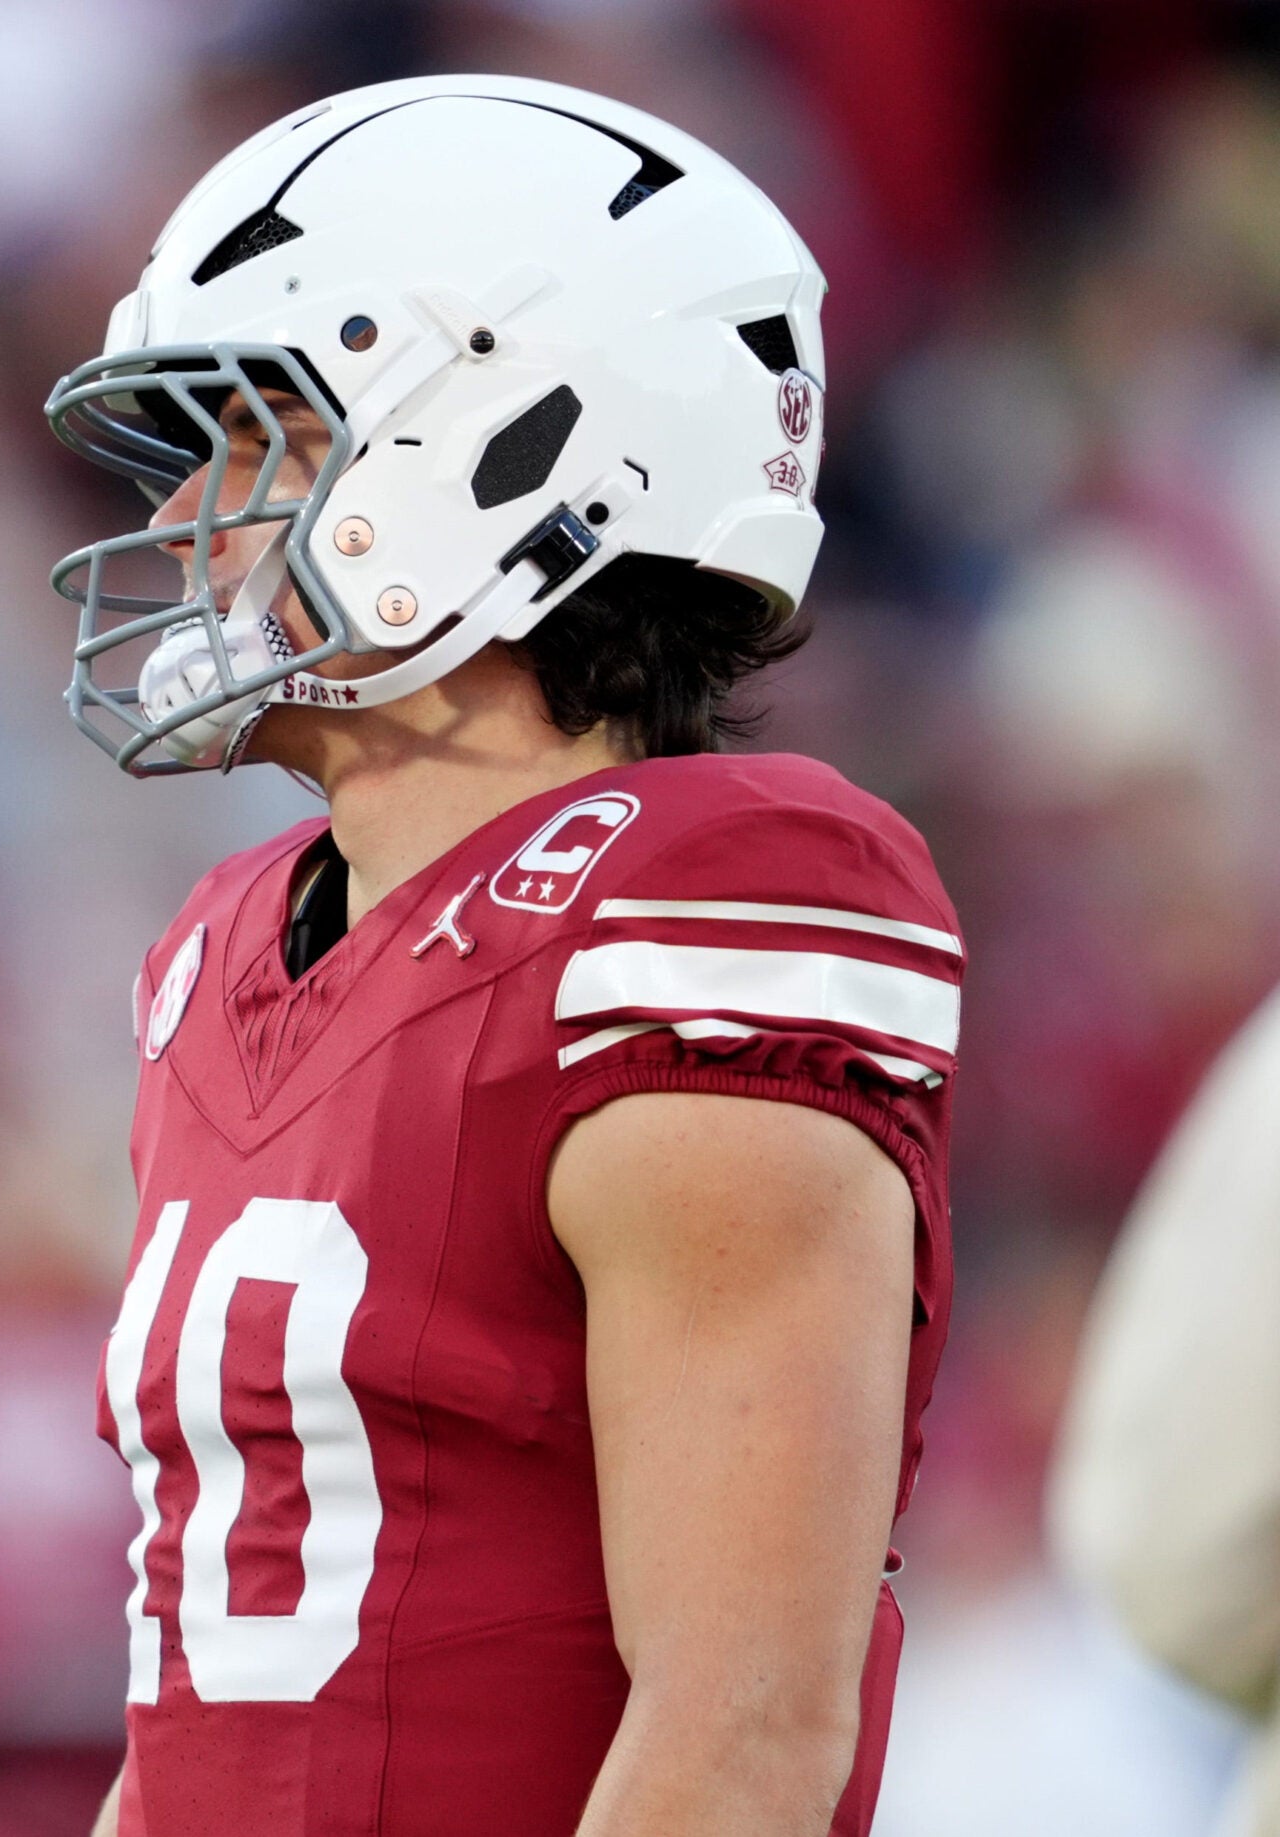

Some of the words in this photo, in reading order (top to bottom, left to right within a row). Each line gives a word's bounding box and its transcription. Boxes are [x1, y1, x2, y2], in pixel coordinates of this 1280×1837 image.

[282, 673, 341, 706] SPORT
[516, 801, 629, 874] C
[106, 1197, 383, 1706] 10
